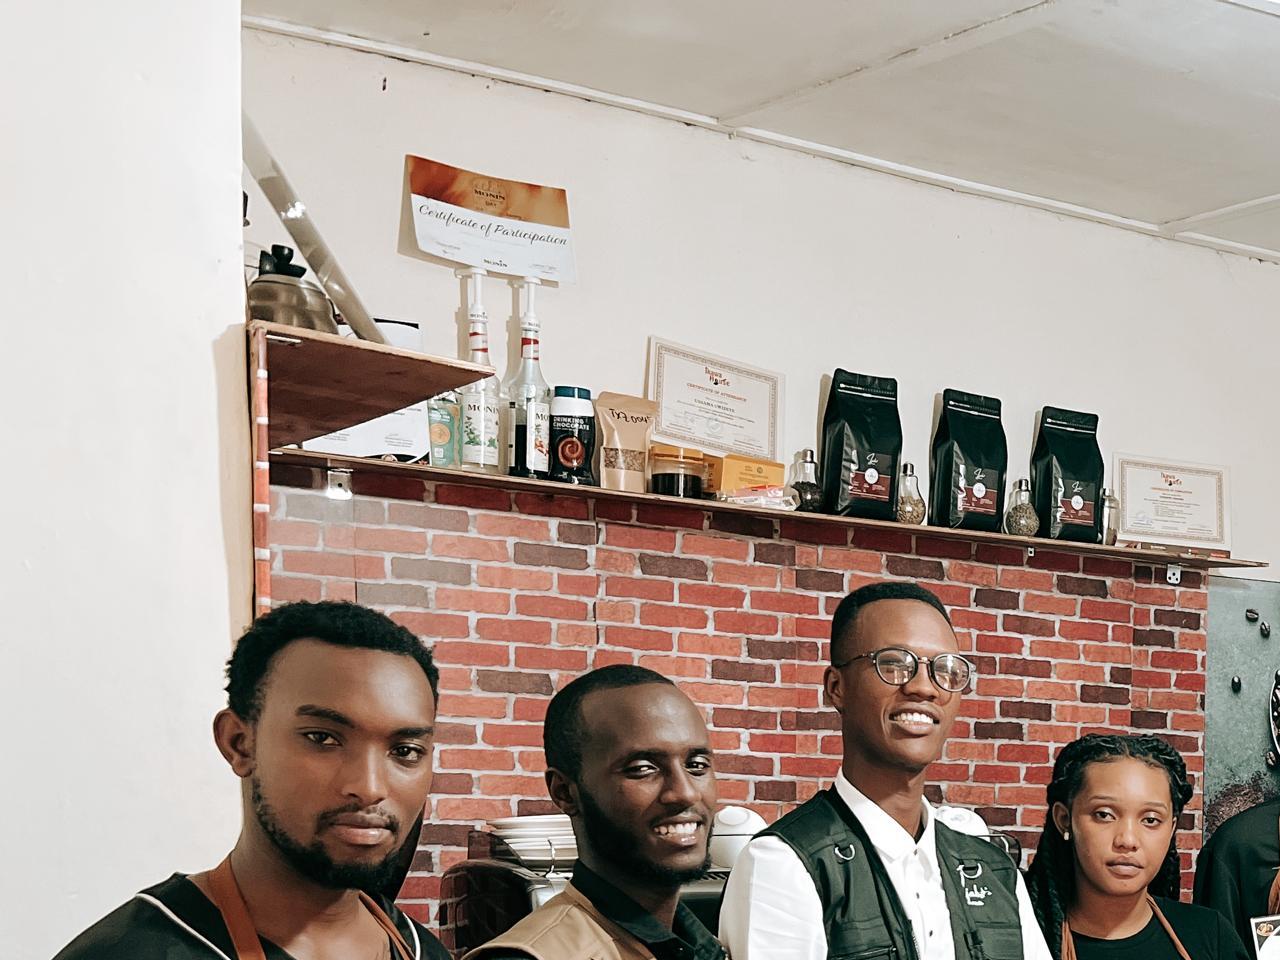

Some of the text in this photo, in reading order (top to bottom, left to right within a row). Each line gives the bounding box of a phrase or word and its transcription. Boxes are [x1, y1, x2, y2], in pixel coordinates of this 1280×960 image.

[419, 204, 567, 245] Certificate of Participation
[553, 422, 589, 430] CHOCOATE
